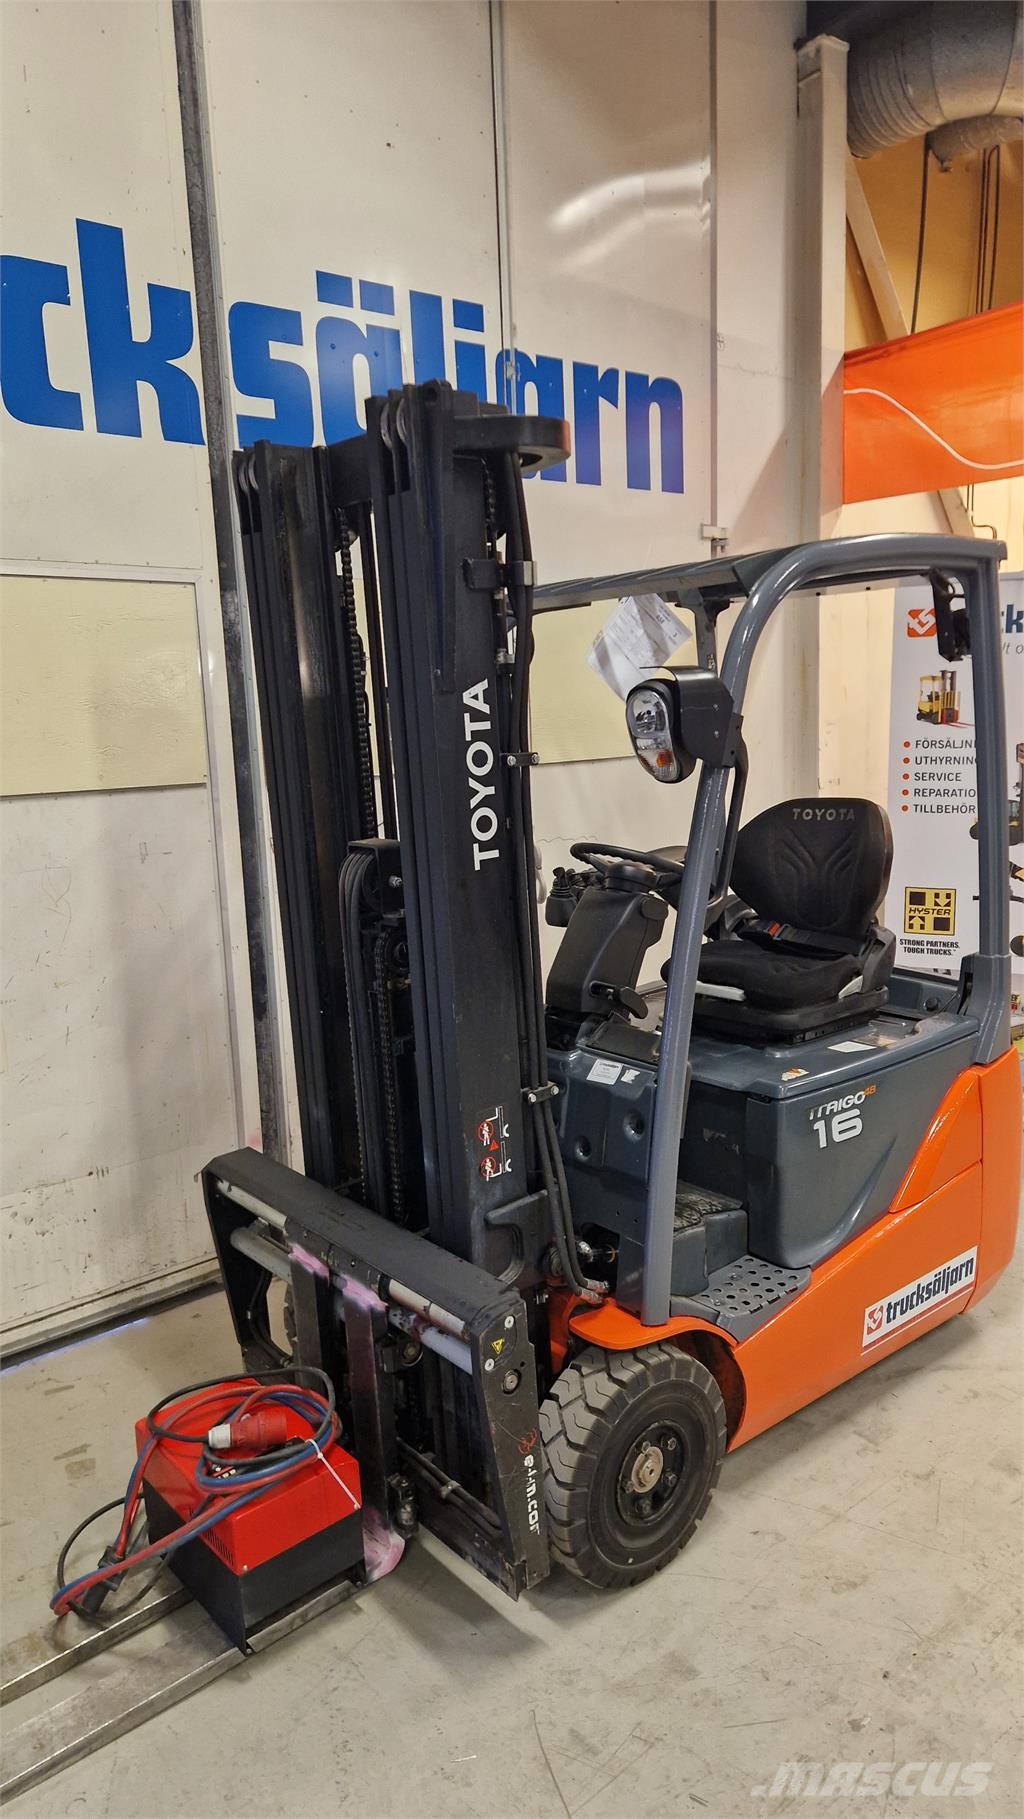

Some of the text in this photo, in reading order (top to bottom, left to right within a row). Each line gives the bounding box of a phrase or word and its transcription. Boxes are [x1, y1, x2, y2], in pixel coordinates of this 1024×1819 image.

[915, 756, 977, 766] UTHYRNIN
[462, 678, 500, 871] TOYOTA
[914, 772, 962, 782] SERVICE
[913, 803, 976, 814] TILLBEHÖR
[792, 808, 856, 821] TOYOTA
[908, 907, 952, 916] HYSTER
[900, 939, 925, 947] STRONG
[813, 1108, 863, 1149] 16
[886, 1257, 975, 1325] trucksäljarn
